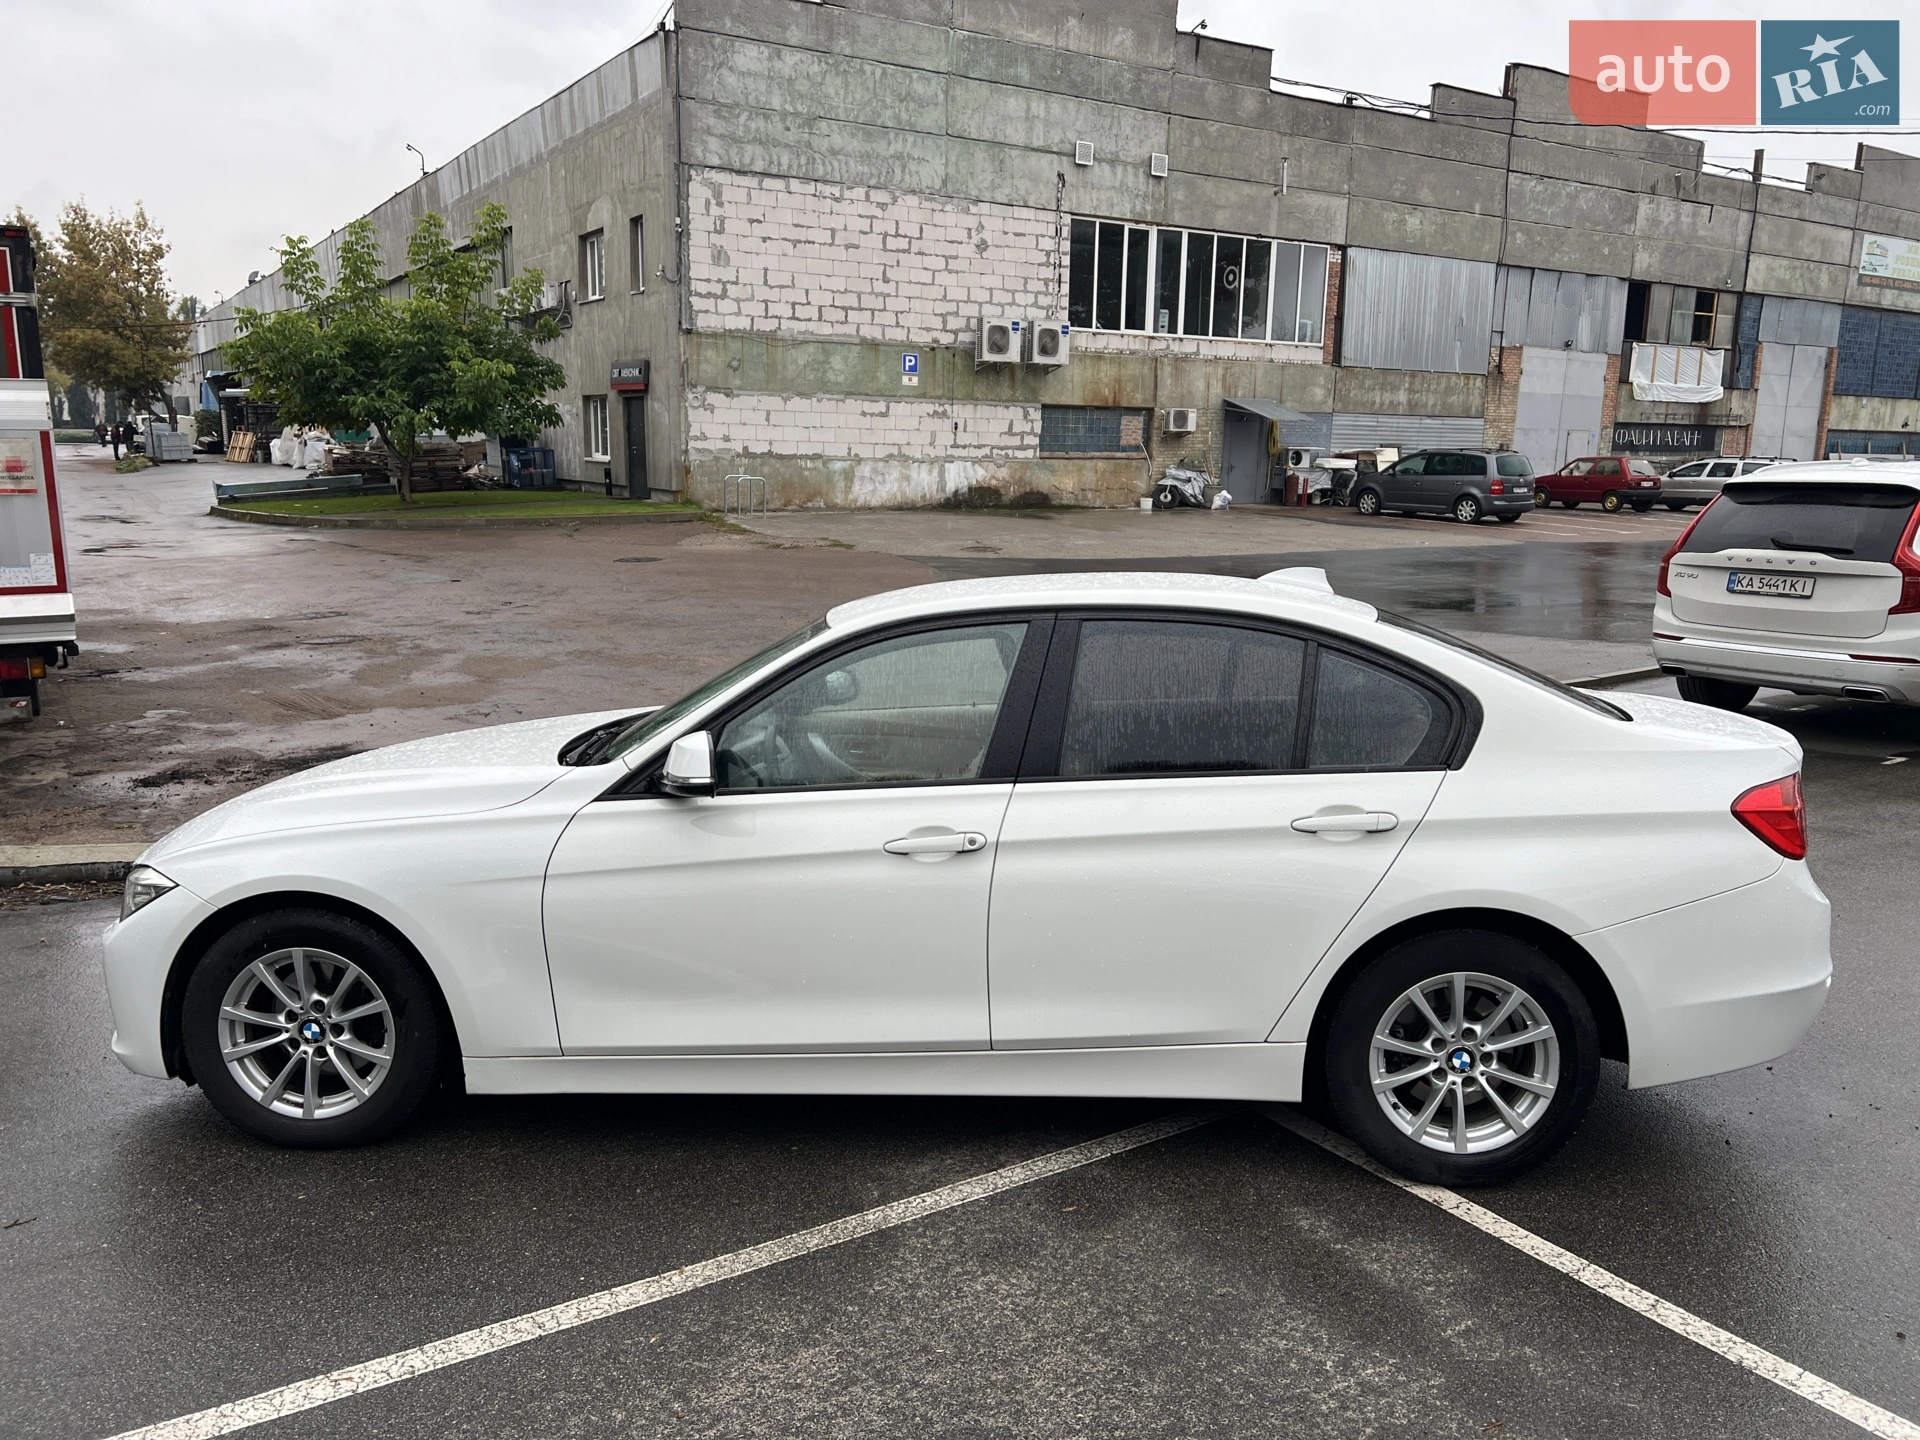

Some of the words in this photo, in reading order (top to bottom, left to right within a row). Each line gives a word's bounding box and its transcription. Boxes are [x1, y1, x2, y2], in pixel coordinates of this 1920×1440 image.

[905, 355, 916, 371] P
[1726, 556, 1818, 566] VOLVO
[1758, 577, 1787, 591] 5441
